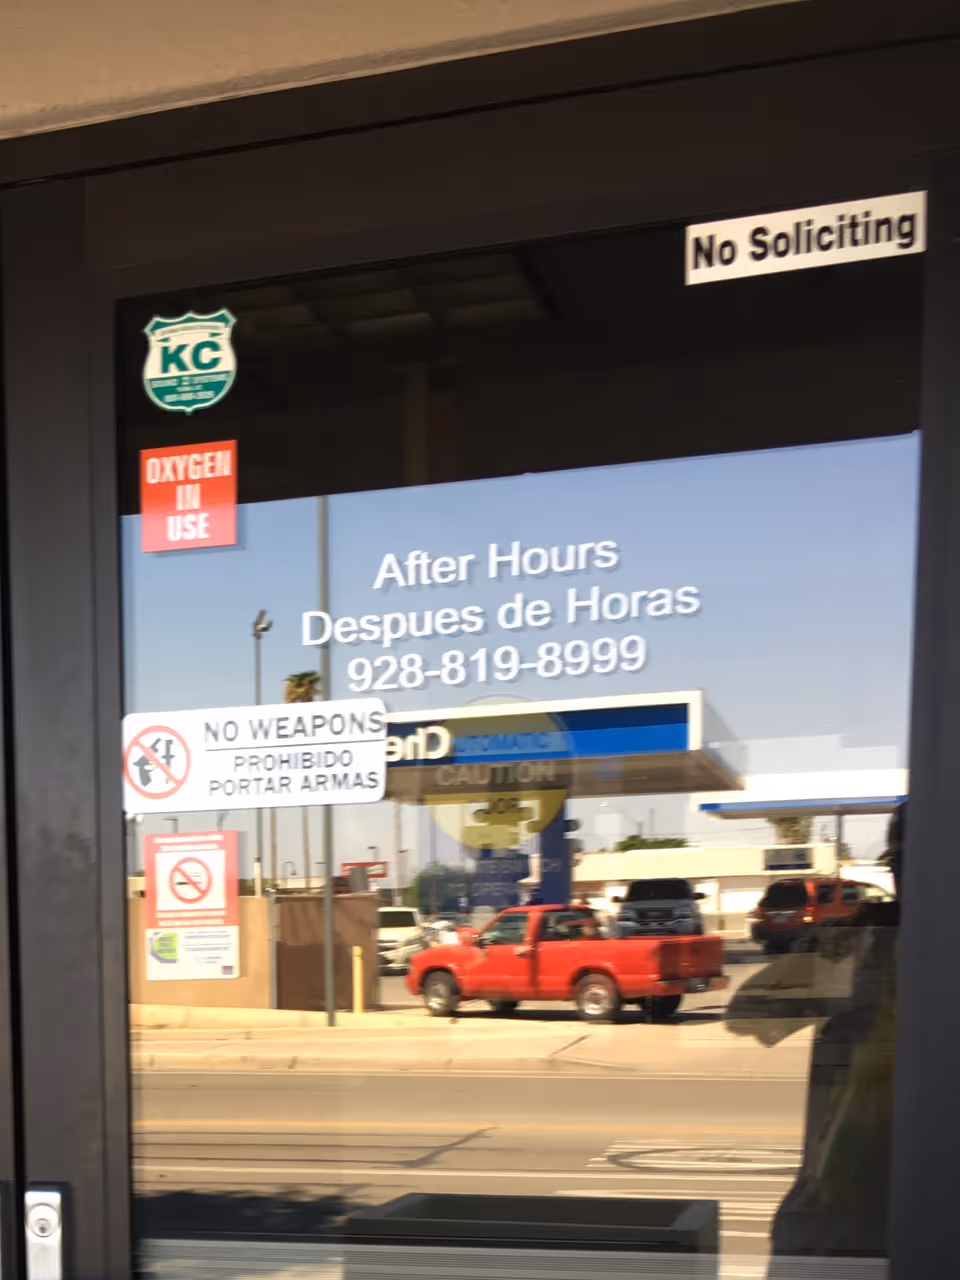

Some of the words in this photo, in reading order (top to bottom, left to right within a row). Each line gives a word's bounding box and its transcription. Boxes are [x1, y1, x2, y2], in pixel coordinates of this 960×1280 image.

[692, 234, 738, 270] No
[749, 211, 917, 262] Soliciting
[160, 340, 222, 375] KC
[145, 450, 232, 484] OXYGEN
[176, 483, 201, 511] IN
[166, 513, 210, 542] USE
[372, 549, 475, 590] After
[488, 539, 619, 579] Hours
[301, 602, 485, 648] Despues
[497, 593, 552, 630] de
[567, 584, 701, 624] Horas
[347, 635, 647, 692] 928-819-8999
[204, 720, 239, 743] NO
[250, 711, 385, 740] WEAPONS
[234, 750, 353, 772] PROHIBIDO
[436, 760, 555, 786] CAUTION
[209, 776, 292, 796] PORTAR
[300, 771, 379, 792] ARMAS
